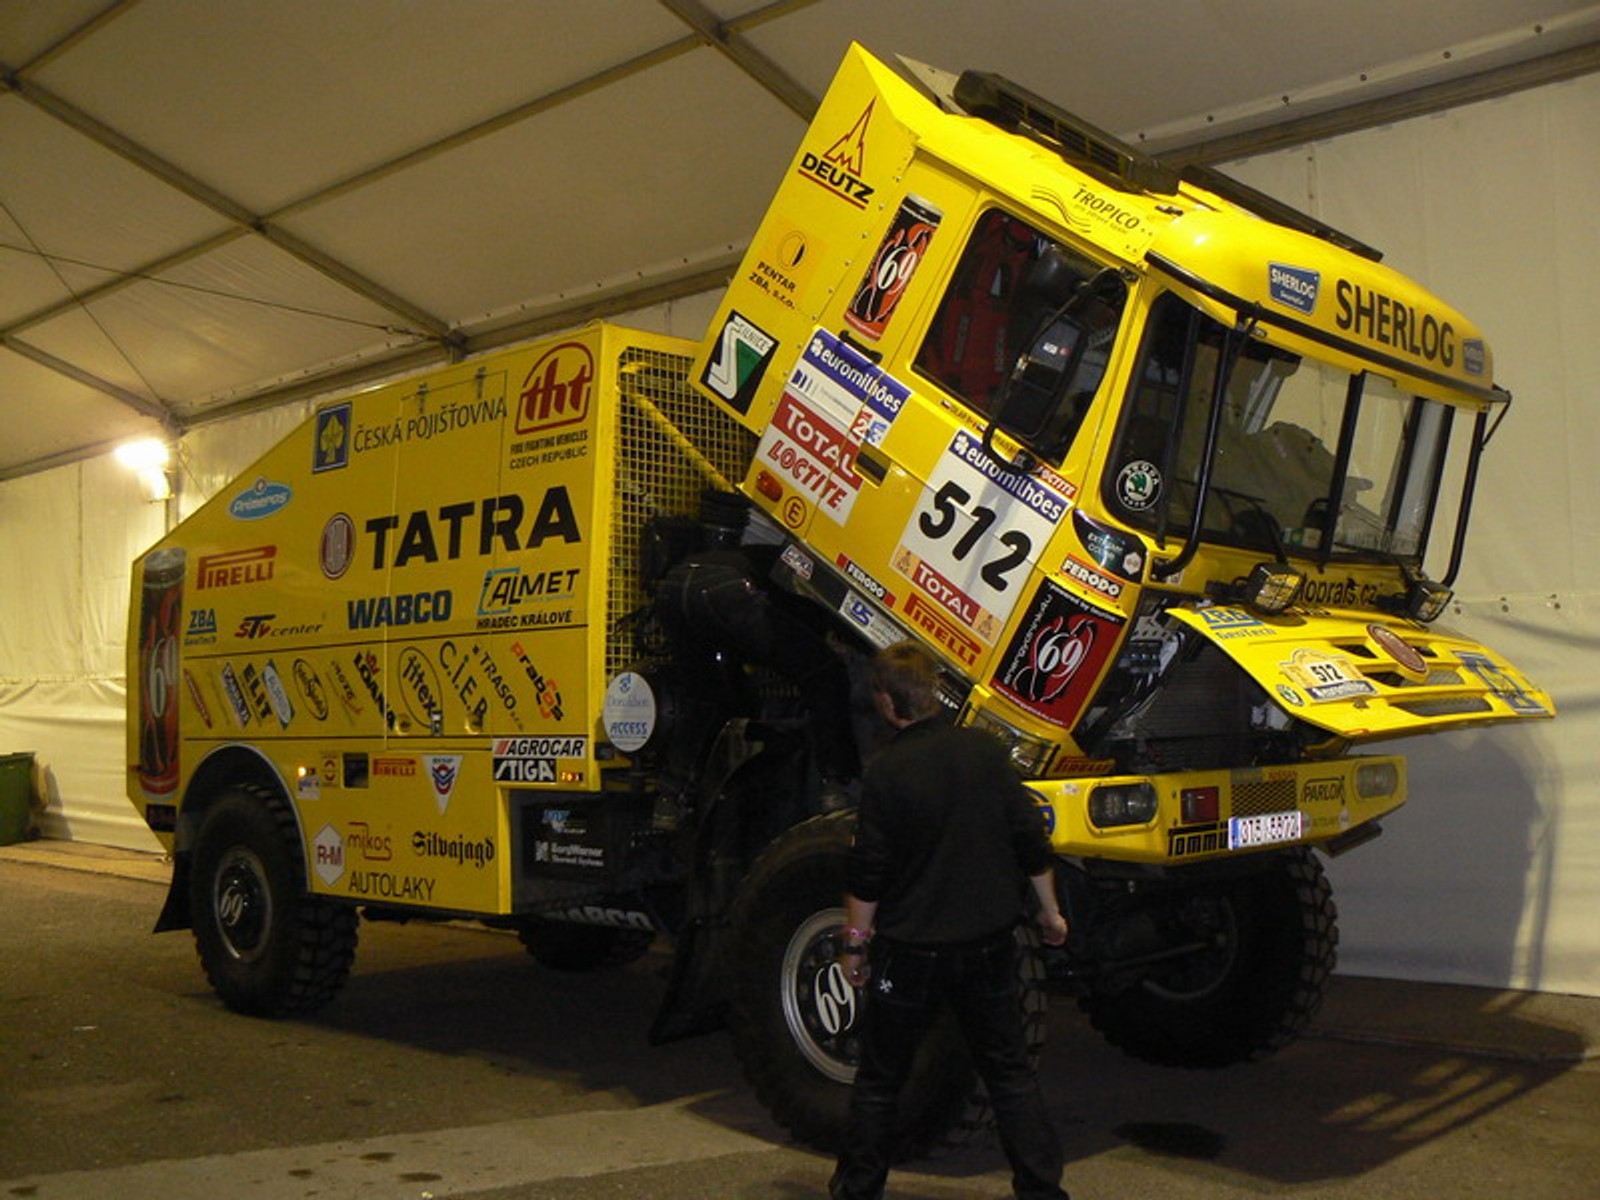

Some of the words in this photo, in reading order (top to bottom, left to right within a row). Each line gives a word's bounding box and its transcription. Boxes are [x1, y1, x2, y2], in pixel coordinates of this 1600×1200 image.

[800, 152, 875, 204] DEUTZ
[1073, 188, 1140, 229] TROPICO
[757, 260, 797, 293] PENTAR
[876, 245, 918, 294] 69
[1272, 268, 1316, 299] SHERLOG
[1336, 279, 1454, 367] SHERLOG
[820, 347, 901, 413] euromilhões
[354, 417, 402, 452] ČESKÁ
[407, 397, 507, 441] POJIŠŤOVNA
[787, 403, 854, 478] TOTAL
[510, 455, 540, 470] CZECH
[542, 446, 588, 464] REPUBLIC
[767, 439, 848, 510] LOCTITE
[966, 449, 1064, 523] euromilhões
[366, 485, 581, 570] TATRA
[918, 480, 1033, 592] 512
[197, 545, 277, 590] PIRELLI
[489, 569, 581, 606] ALMET
[848, 561, 885, 597] FERODO
[1062, 560, 1120, 597] FERODO
[347, 590, 453, 630] WABCO
[919, 564, 978, 625] TOTAL
[189, 608, 217, 628] ZBA
[271, 623, 323, 637] center
[476, 615, 518, 630] HRADEC
[520, 610, 573, 627] KRÁLOVÉ
[903, 592, 982, 666] PIRELLI
[1038, 632, 1084, 679] 69
[1310, 663, 1343, 682] 512
[243, 663, 273, 719] ELIT
[480, 652, 516, 710] TRASO
[507, 740, 584, 756] AGROCAR
[610, 721, 648, 735] ACCESS
[373, 758, 416, 776] PIRELLI
[412, 831, 495, 868] Silvajagd
[349, 871, 435, 900] AUTOLAKY
[815, 962, 855, 1034] 69
